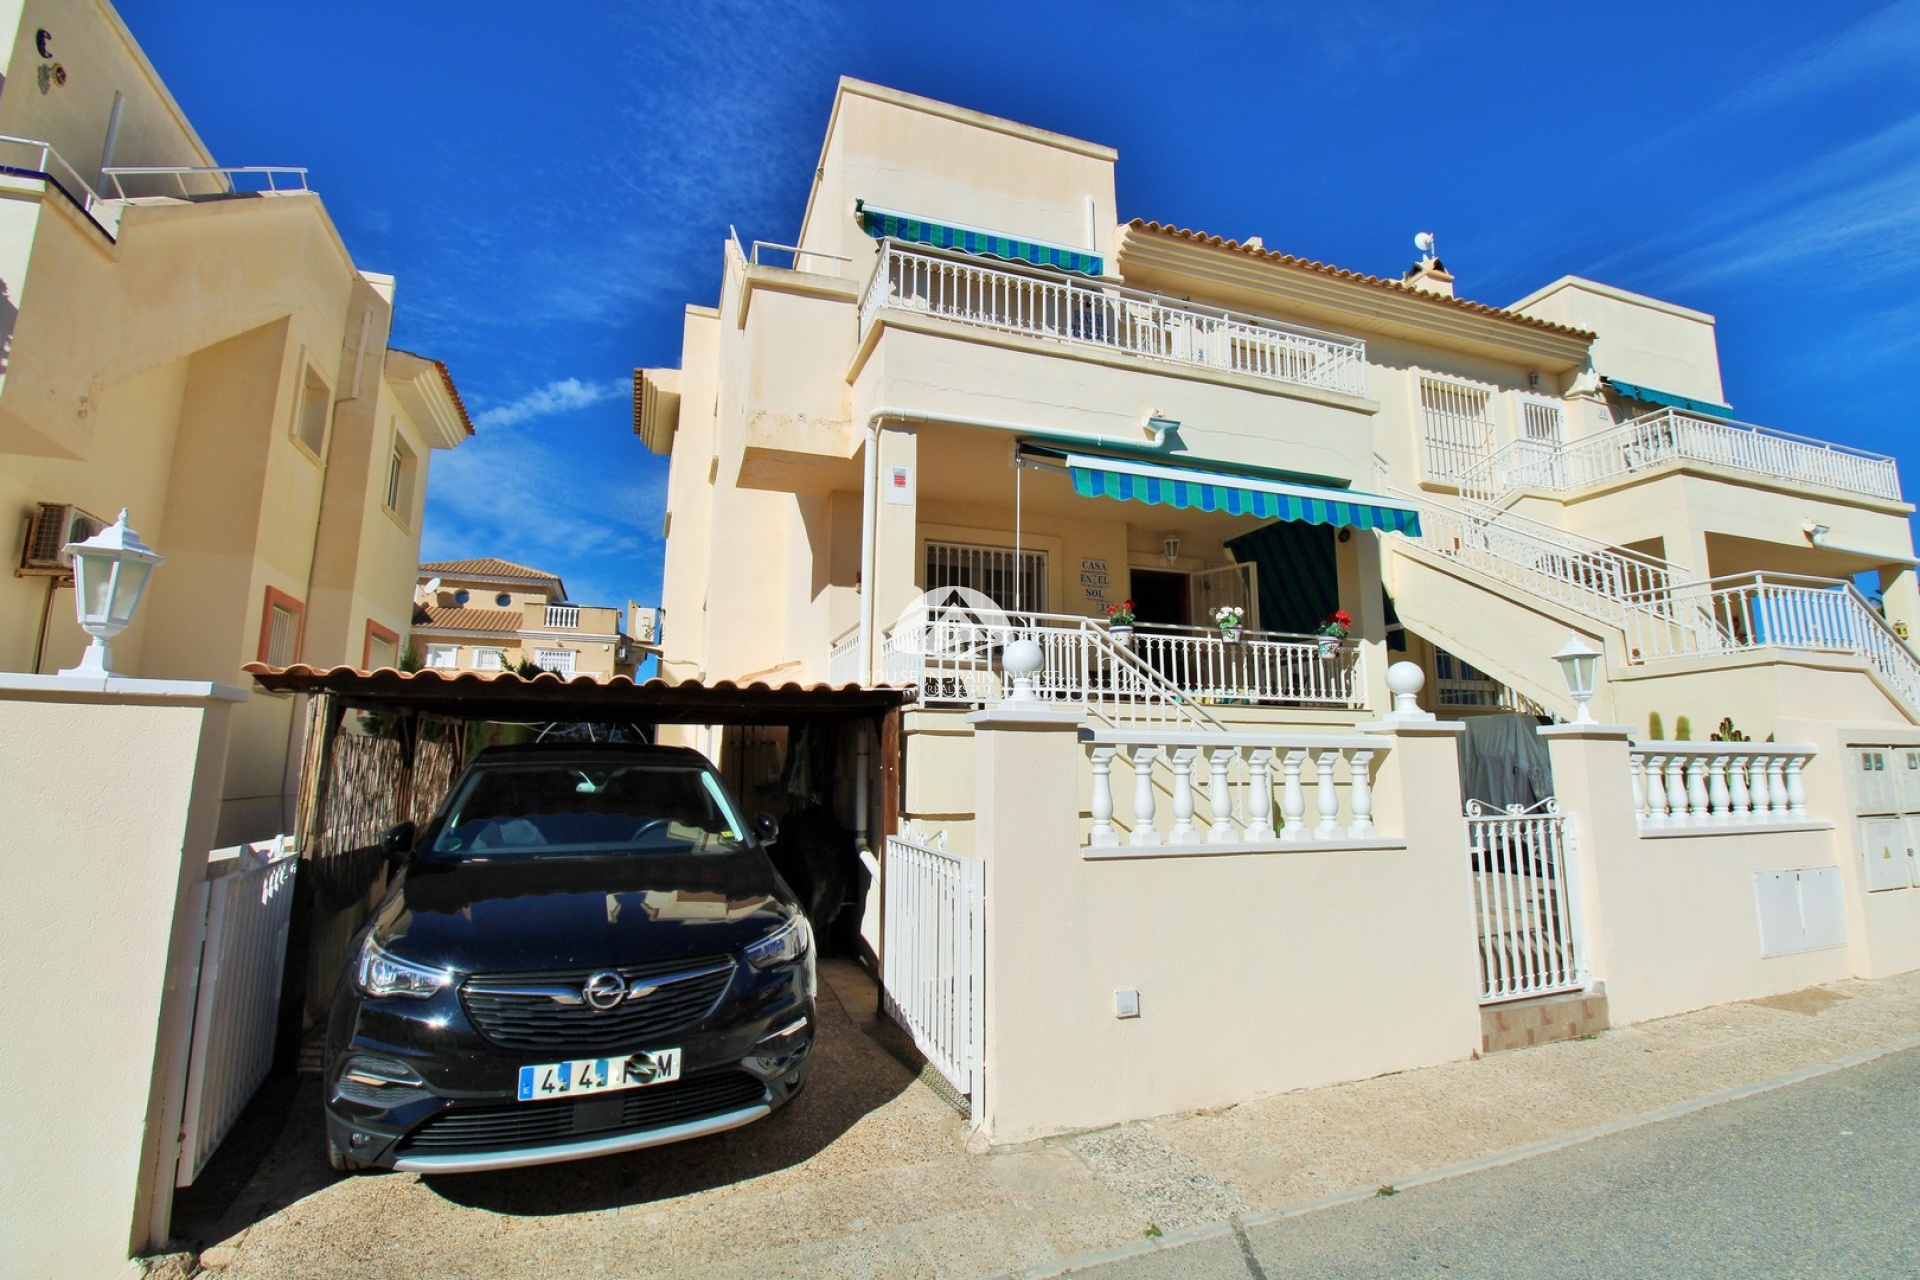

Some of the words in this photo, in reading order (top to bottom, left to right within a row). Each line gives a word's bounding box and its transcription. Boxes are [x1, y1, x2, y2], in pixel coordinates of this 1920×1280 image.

[1081, 560, 1107, 571] CASA
[1080, 574, 1092, 584] EN
[1097, 575, 1109, 585] EL
[1085, 588, 1104, 598] SOL
